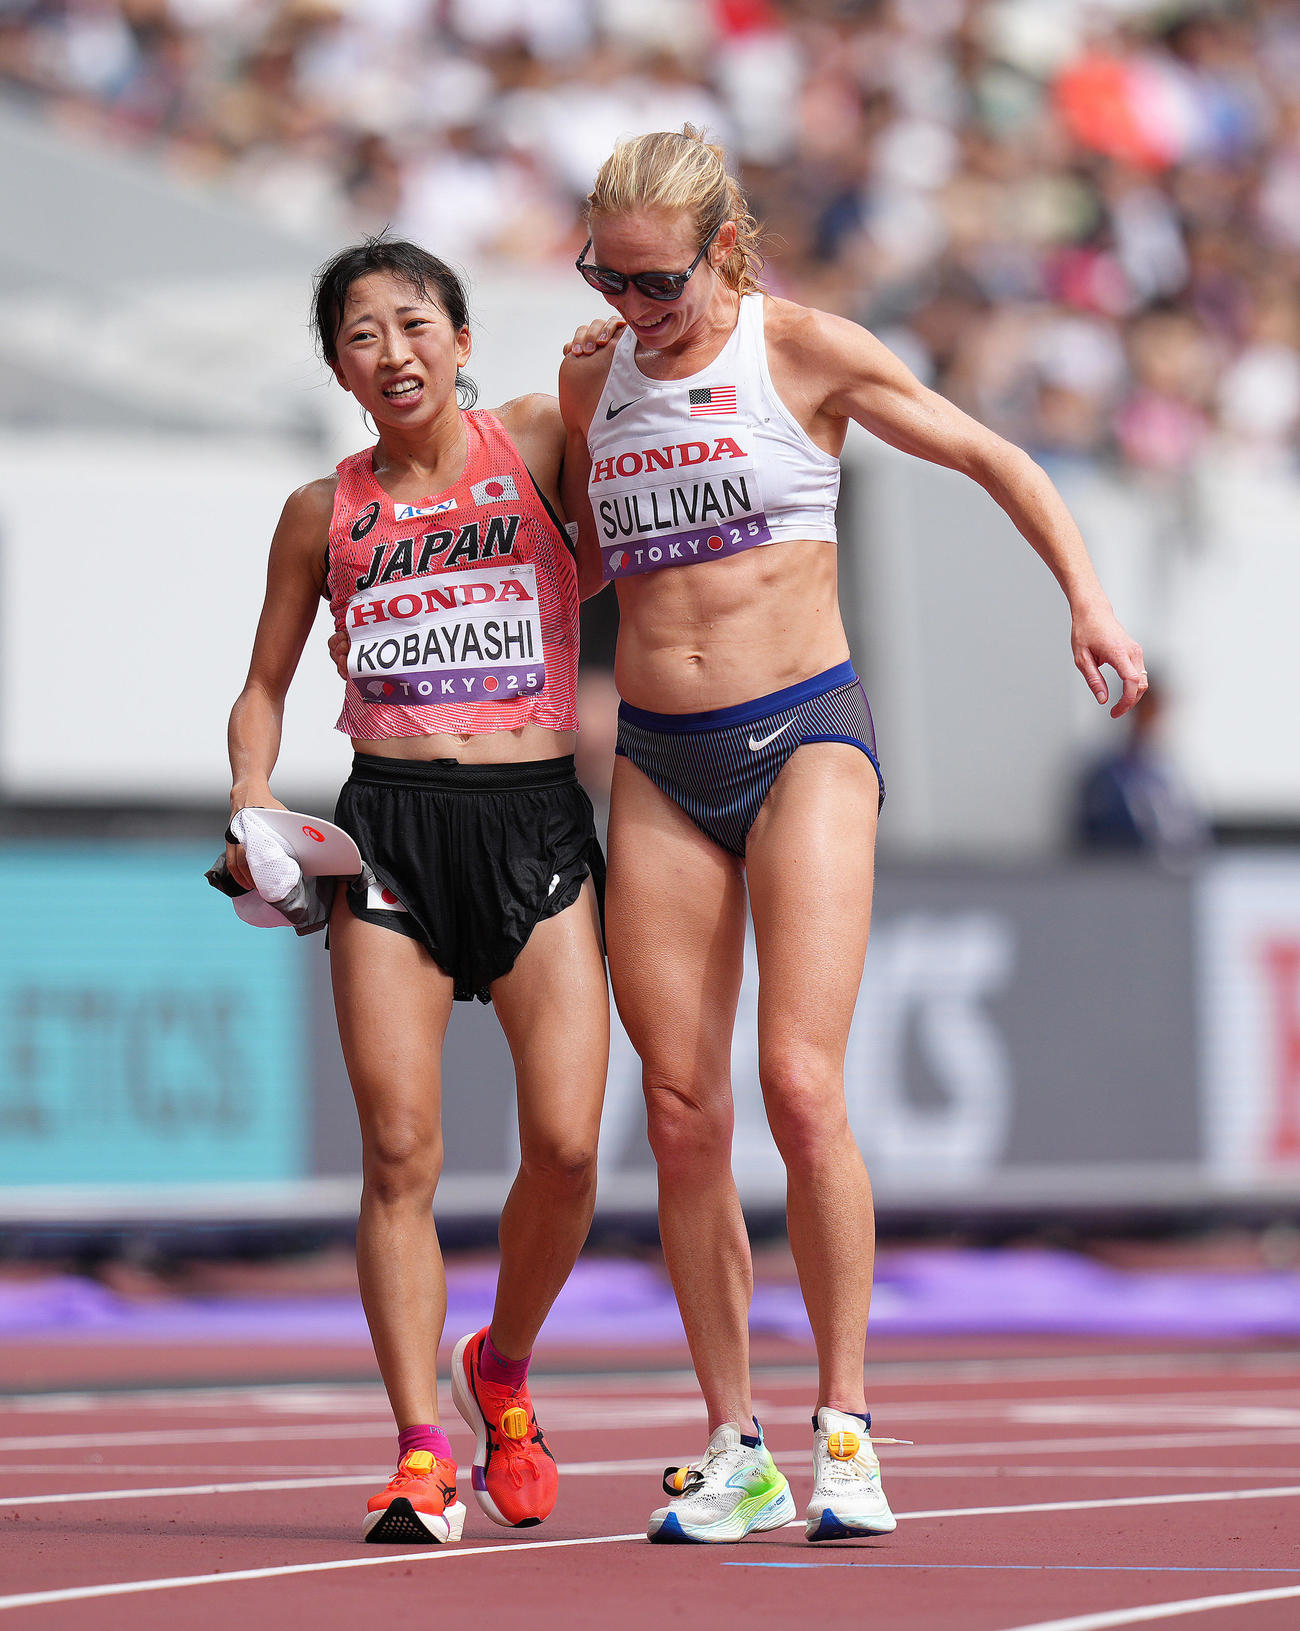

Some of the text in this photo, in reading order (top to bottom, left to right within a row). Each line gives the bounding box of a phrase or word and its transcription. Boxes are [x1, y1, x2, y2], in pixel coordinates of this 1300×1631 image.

[592, 437, 748, 483] HONDA
[600, 477, 752, 539] SULLIVAN
[356, 515, 520, 591] JAPAN
[730, 521, 759, 544] 25
[351, 580, 534, 628] HONDA
[357, 620, 534, 671] KOBAYASHI
[506, 673, 537, 689] 25
